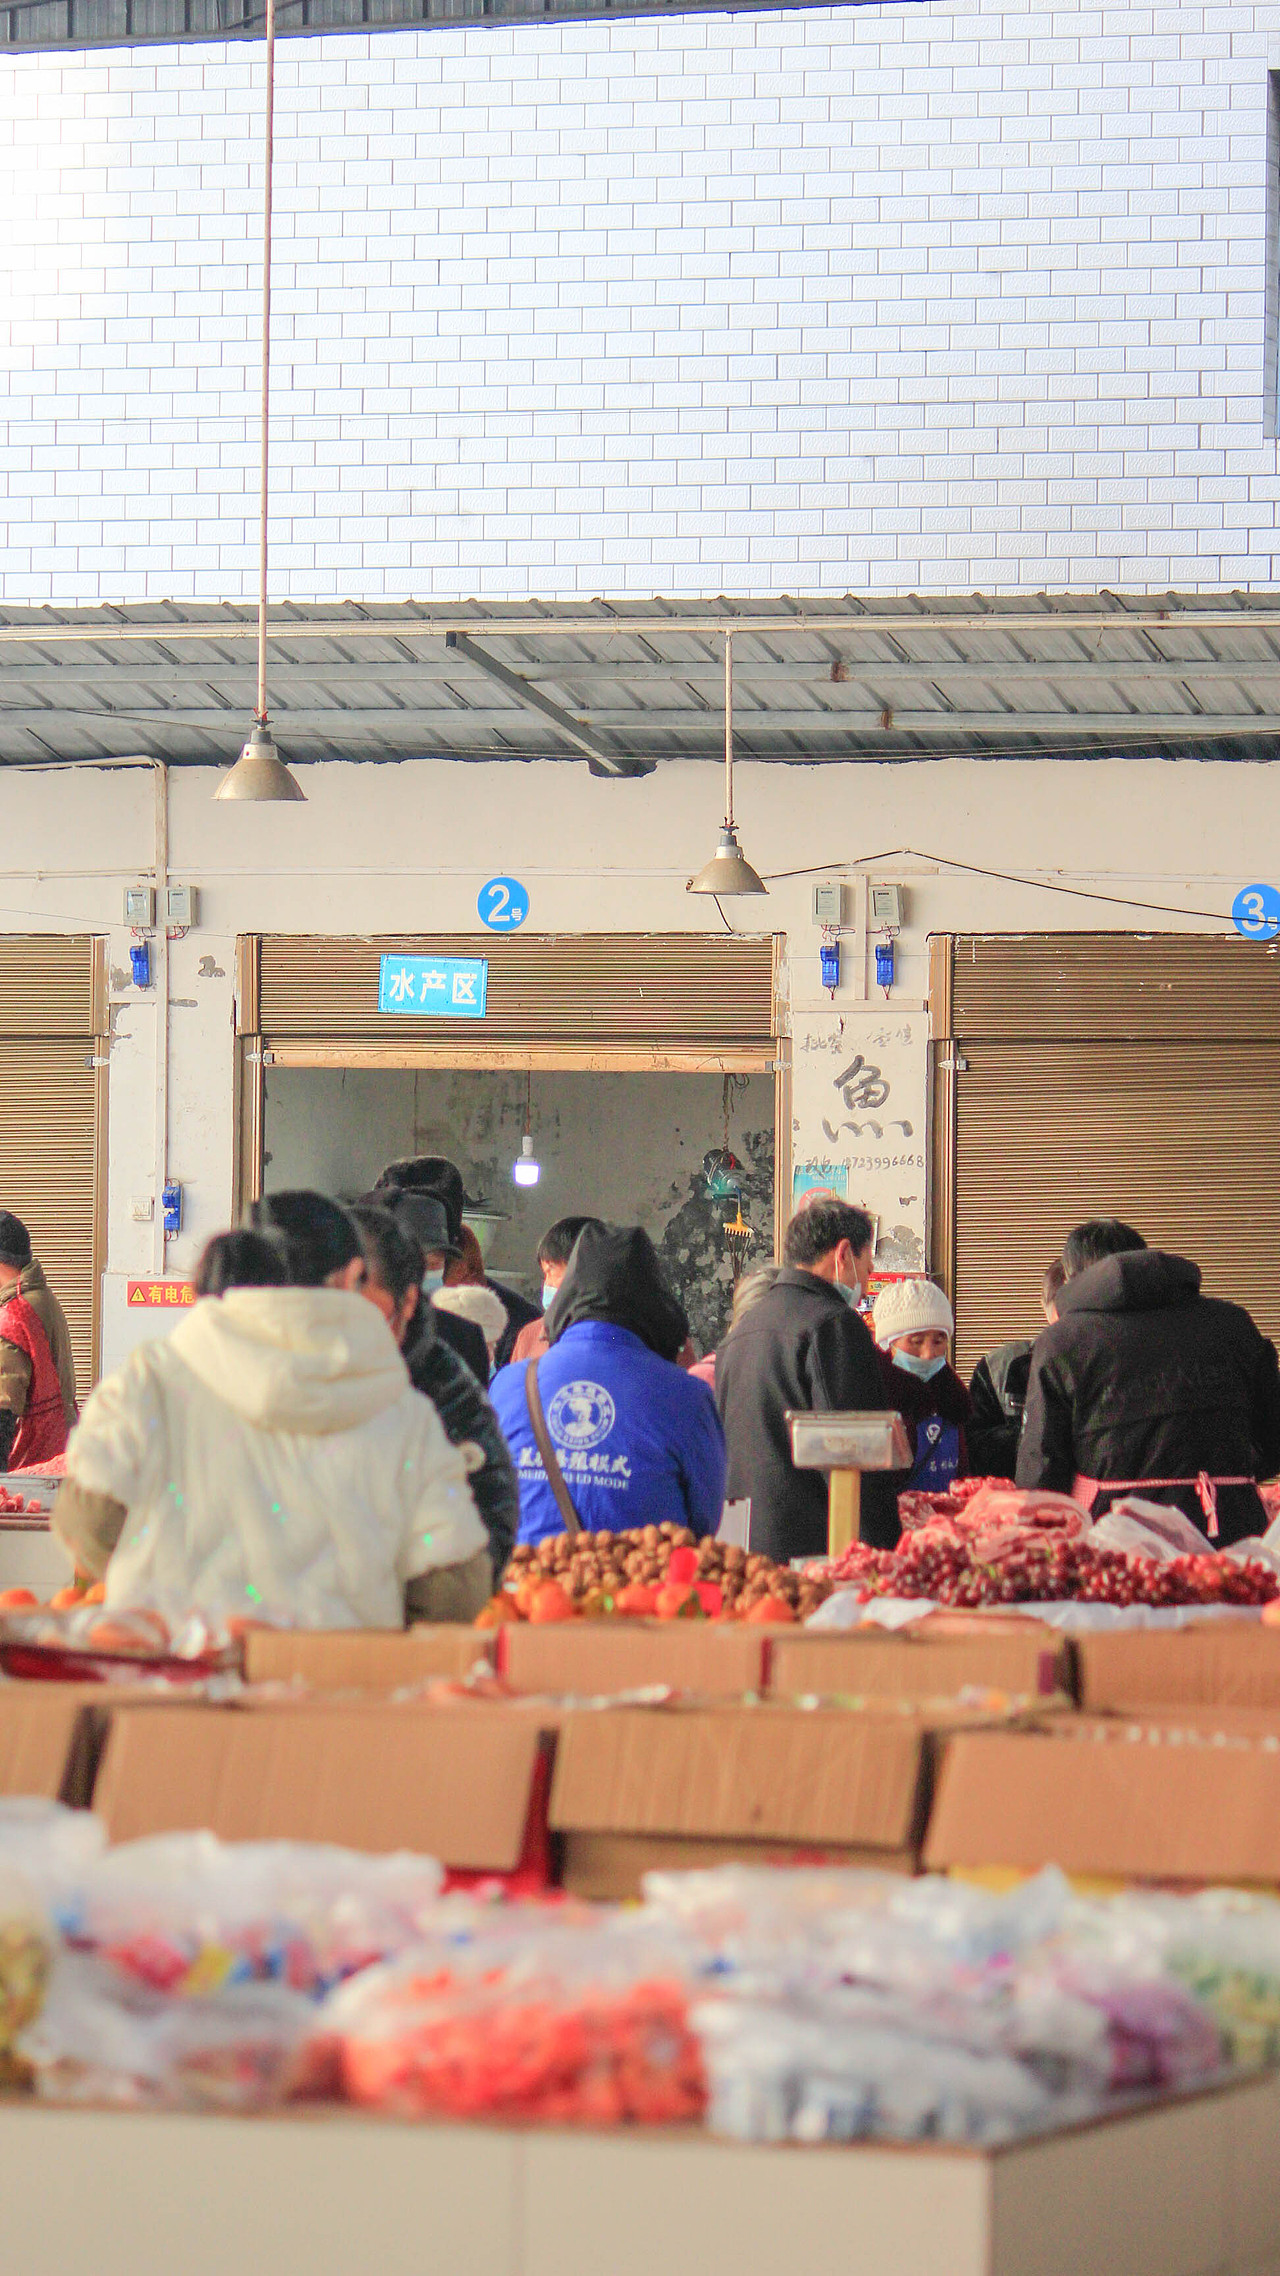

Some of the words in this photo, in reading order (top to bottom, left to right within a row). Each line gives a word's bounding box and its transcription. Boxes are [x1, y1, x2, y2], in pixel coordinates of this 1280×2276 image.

[488, 884, 523, 923] 2号
[389, 967, 478, 1005] 水产区
